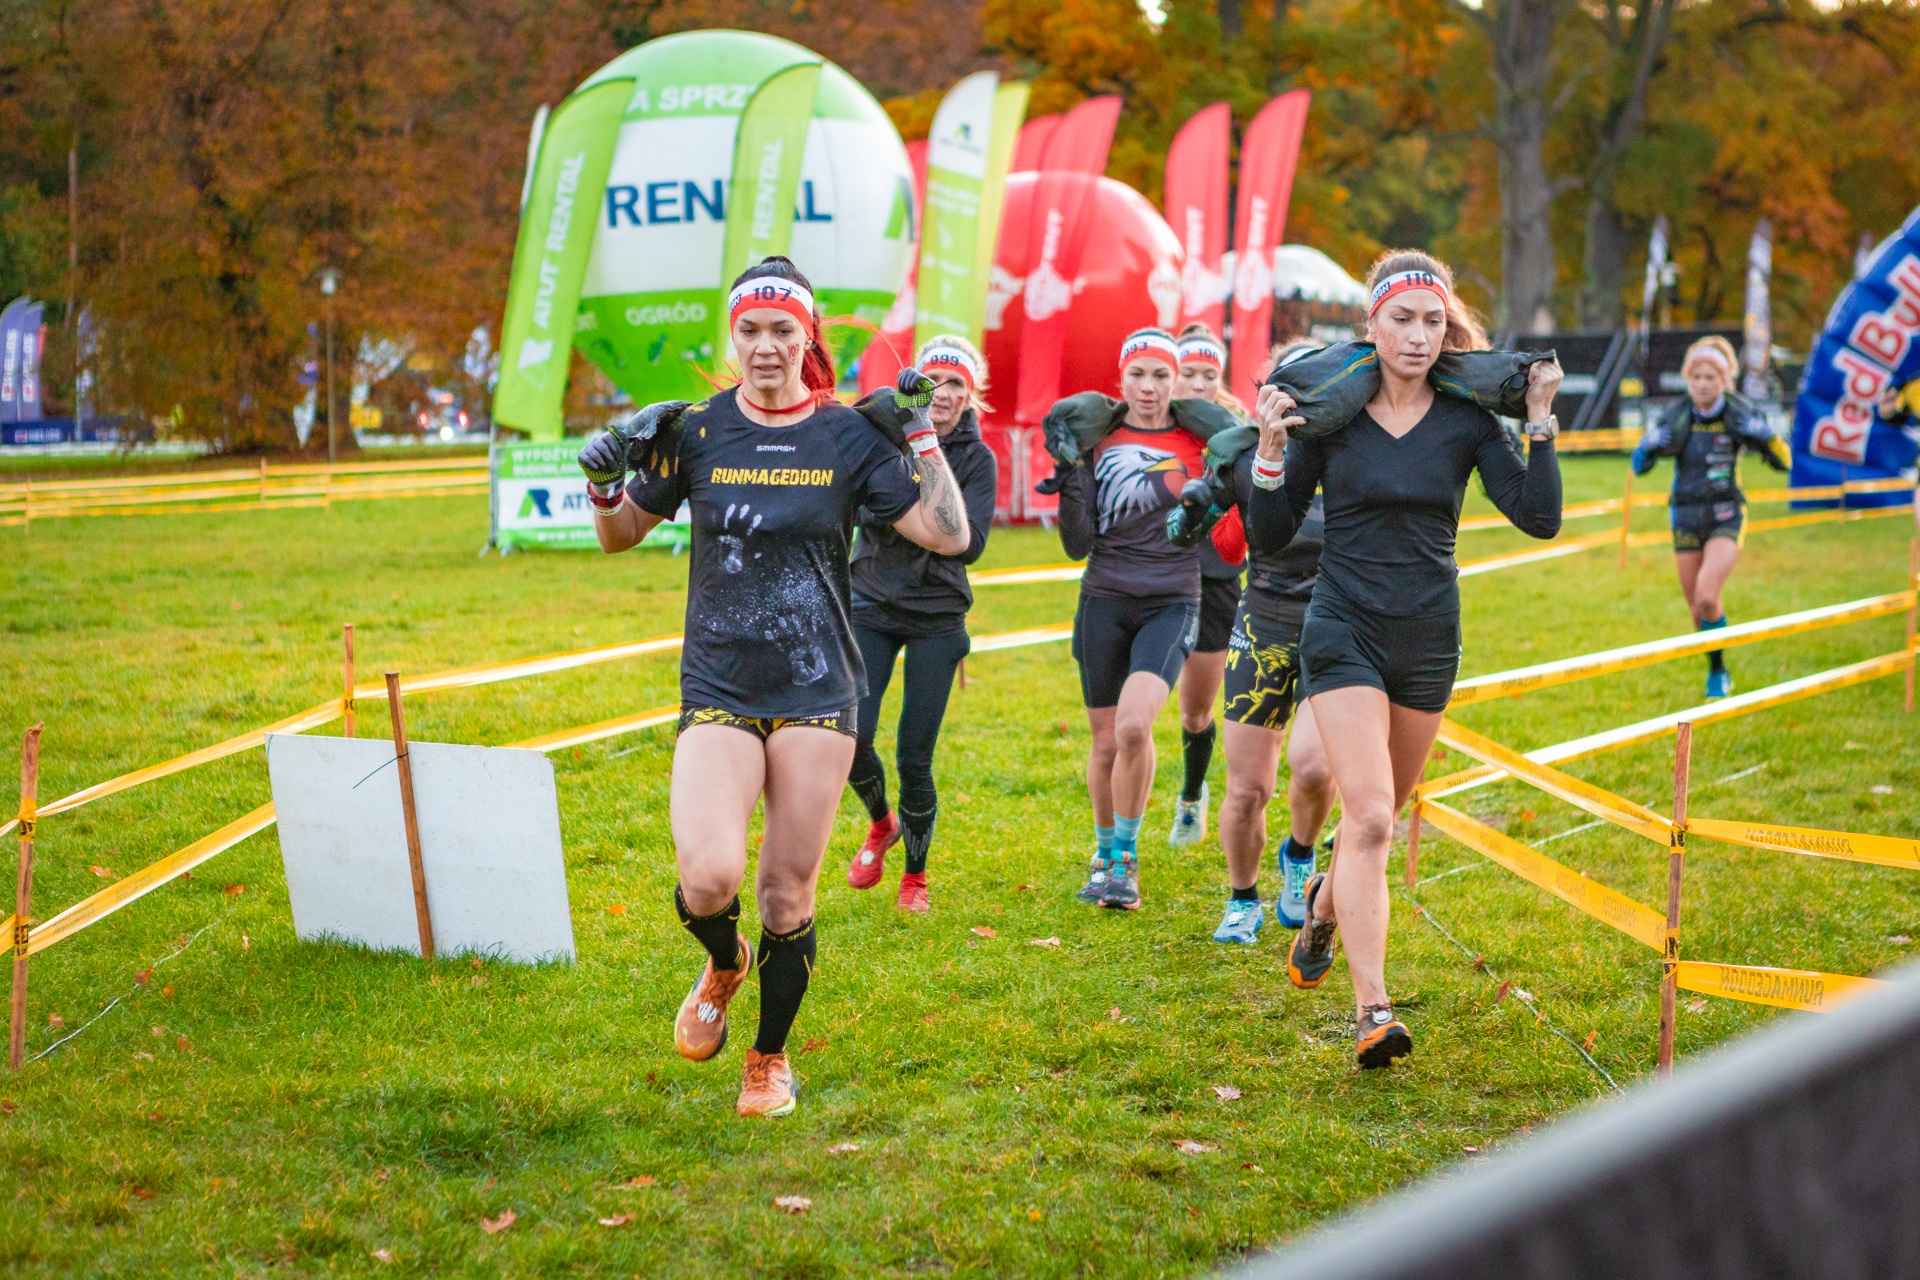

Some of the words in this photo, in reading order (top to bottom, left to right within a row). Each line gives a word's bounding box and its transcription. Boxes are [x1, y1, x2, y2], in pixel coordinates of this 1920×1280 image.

[751, 138, 784, 241] RENTAL
[545, 151, 587, 253] RENTAL
[1404, 273, 1434, 287] 110
[533, 257, 561, 331] ATUT
[753, 286, 793, 302] 107
[625, 301, 707, 326] OGRÓD
[787, 343, 800, 359] 107
[1124, 341, 1148, 359] 093
[930, 354, 959, 367] 099
[1812, 349, 1891, 465] Red
[711, 467, 834, 487] RUNMAGEDDON
